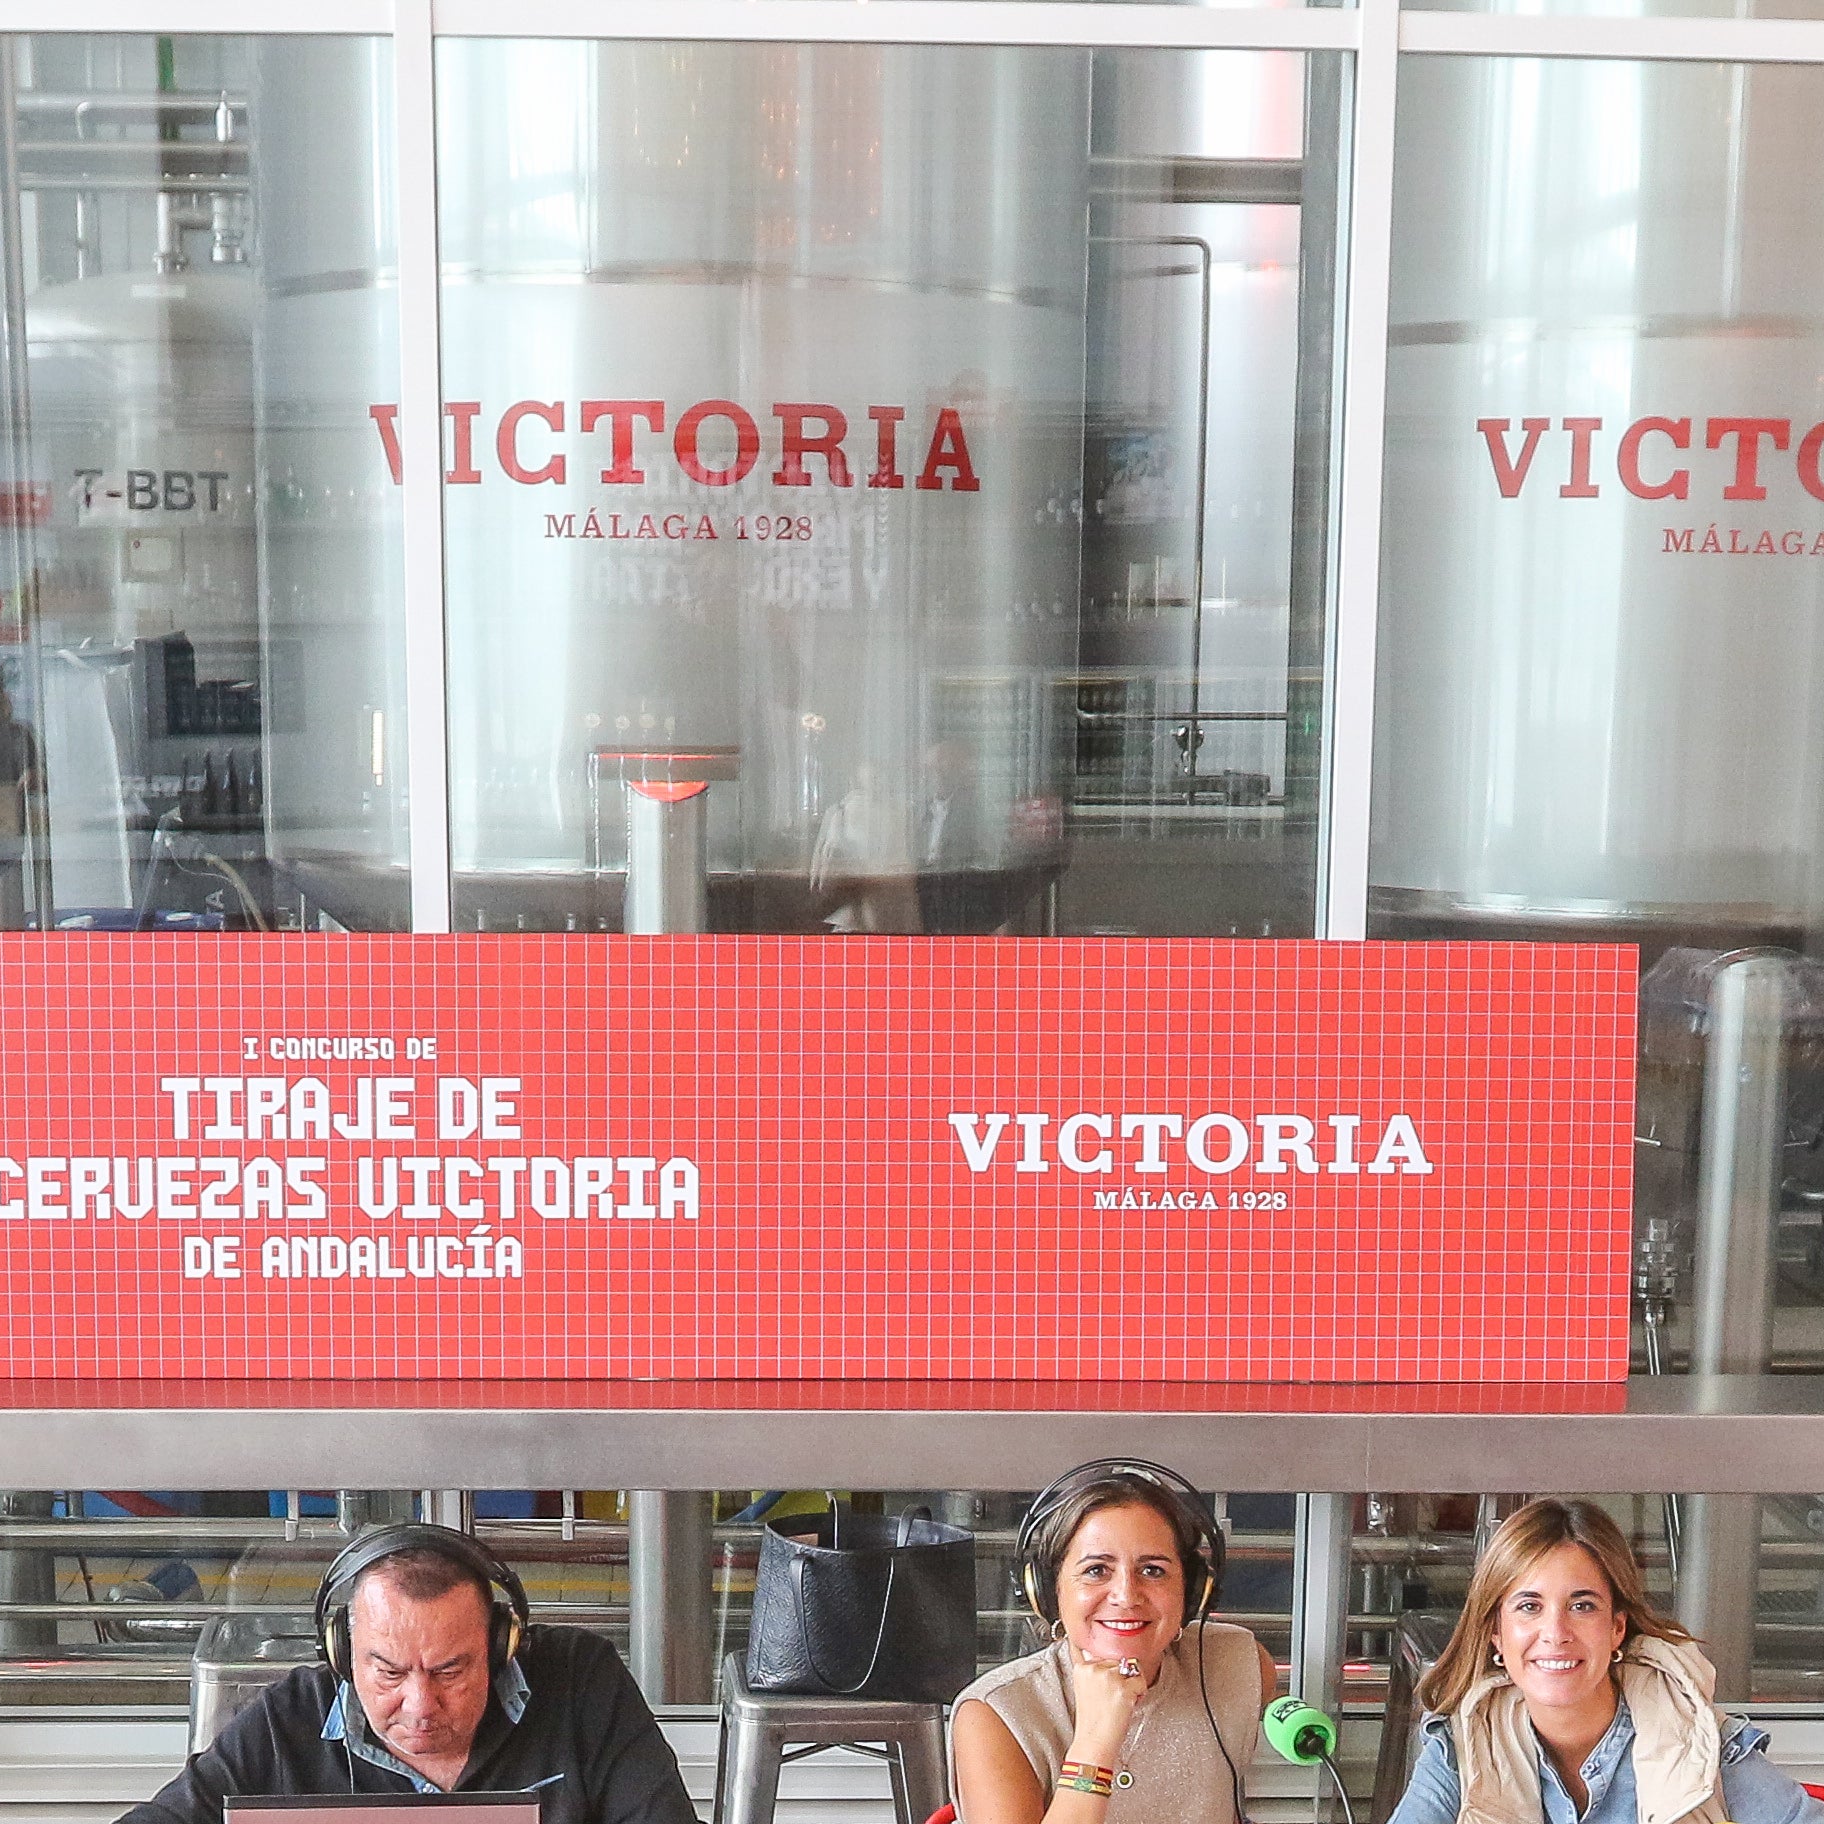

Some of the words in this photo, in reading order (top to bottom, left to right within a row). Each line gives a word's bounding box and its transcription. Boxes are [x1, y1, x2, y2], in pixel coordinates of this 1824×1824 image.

[544, 507, 718, 539] MÁLAGA
[733, 515, 813, 540] 1928
[244, 1038, 258, 1060] I
[270, 1037, 395, 1061] CONCURSO
[407, 1038, 437, 1060] DE
[161, 1077, 415, 1140] TIRAJE
[438, 1077, 521, 1140] DE
[948, 1113, 1433, 1174] VICTORIA
[357, 1157, 700, 1220] VICTORIA
[1093, 1187, 1219, 1210] MÁLAGA
[1228, 1191, 1288, 1211] 1928
[184, 1236, 241, 1278] DE
[262, 1225, 522, 1279] ANDALUCÍA
